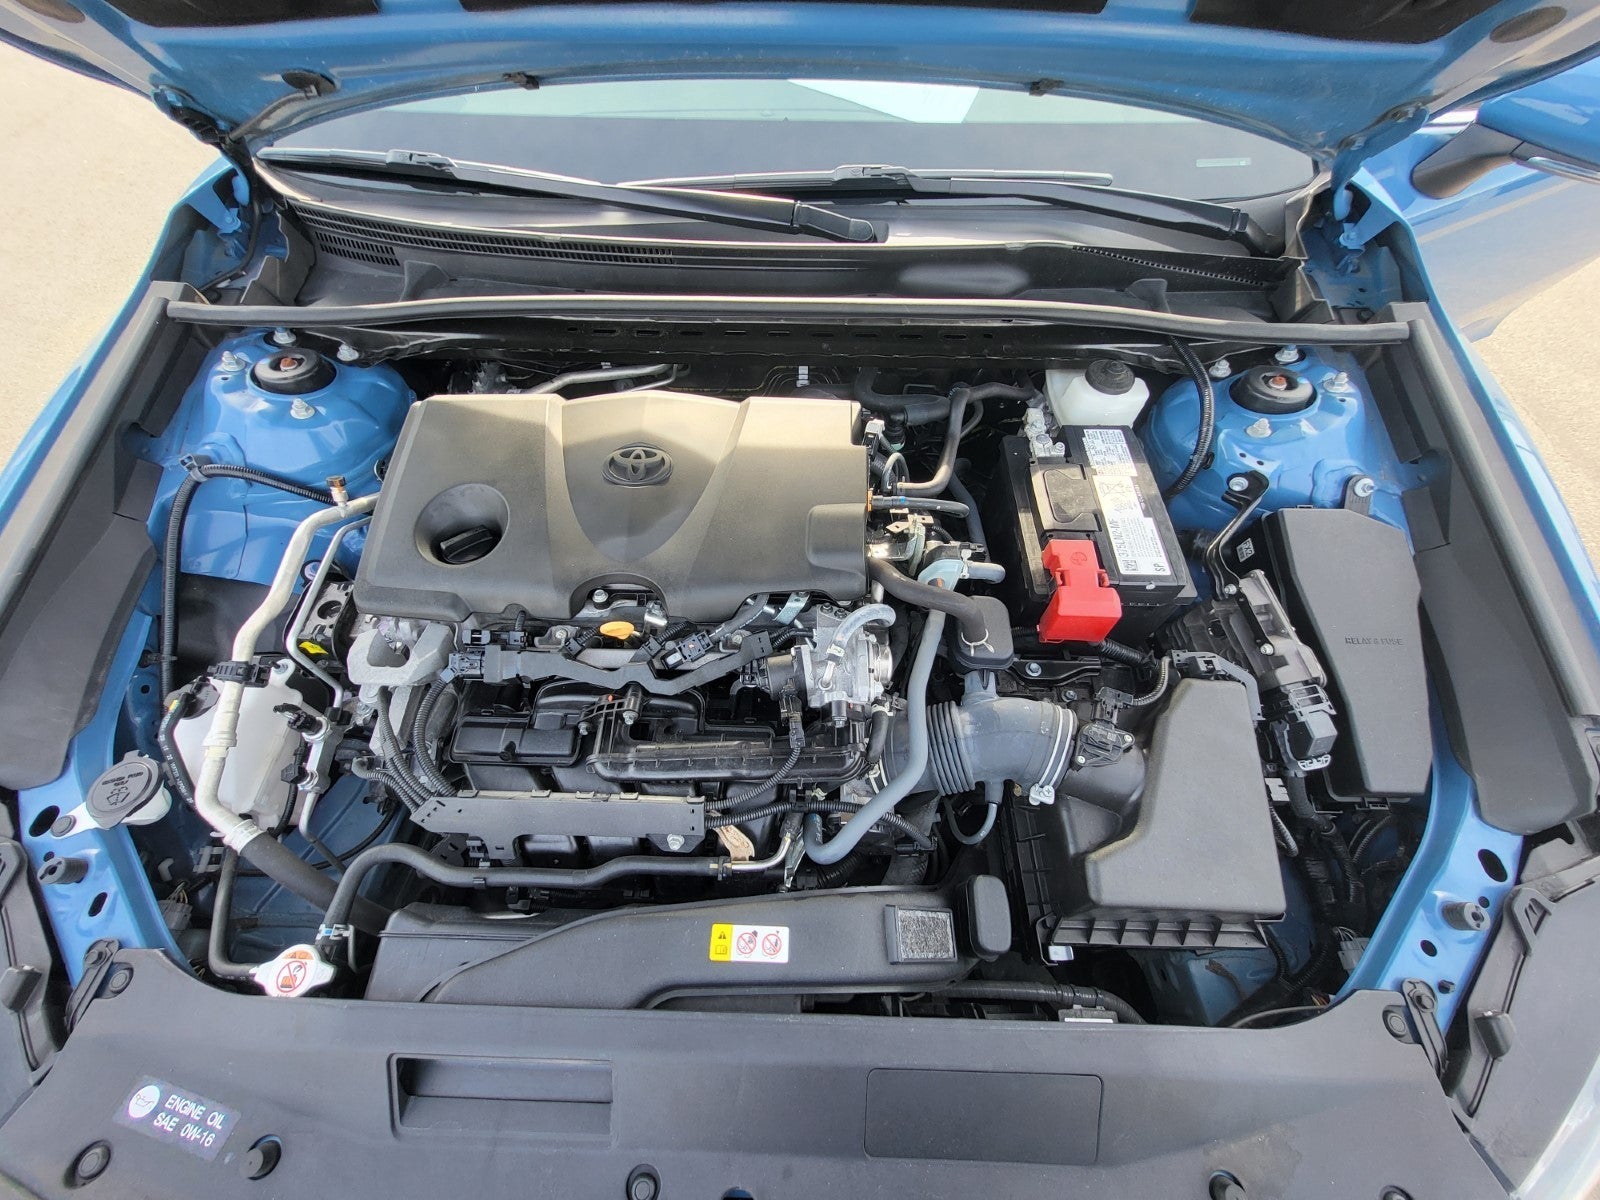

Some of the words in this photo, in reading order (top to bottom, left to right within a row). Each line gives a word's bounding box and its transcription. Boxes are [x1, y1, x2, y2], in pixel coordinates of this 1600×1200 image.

[1153, 563, 1166, 572] SP
[1344, 637, 1372, 645] RELAY
[1380, 638, 1404, 646] FUSE
[165, 1095, 206, 1120] ENGINE
[206, 1111, 226, 1130] OIL
[153, 1112, 180, 1132] SAE
[180, 1124, 216, 1146] 0W-16
